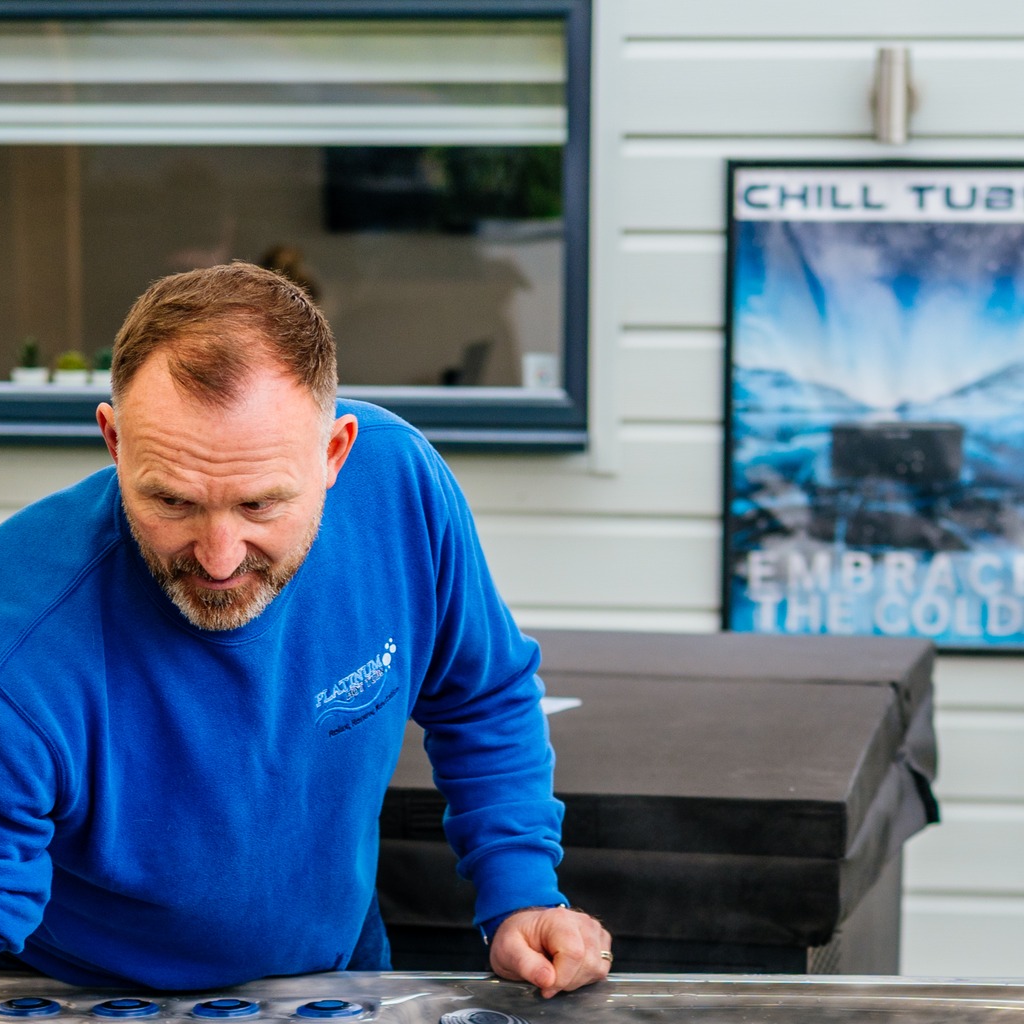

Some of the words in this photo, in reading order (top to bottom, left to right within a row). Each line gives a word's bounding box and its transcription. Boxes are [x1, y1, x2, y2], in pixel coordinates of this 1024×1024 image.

[742, 184, 885, 210] CHILL
[908, 185, 1024, 211] TUB
[752, 596, 856, 633] THE
[875, 594, 1024, 637] COLD
[315, 653, 383, 708] PLATINUM
